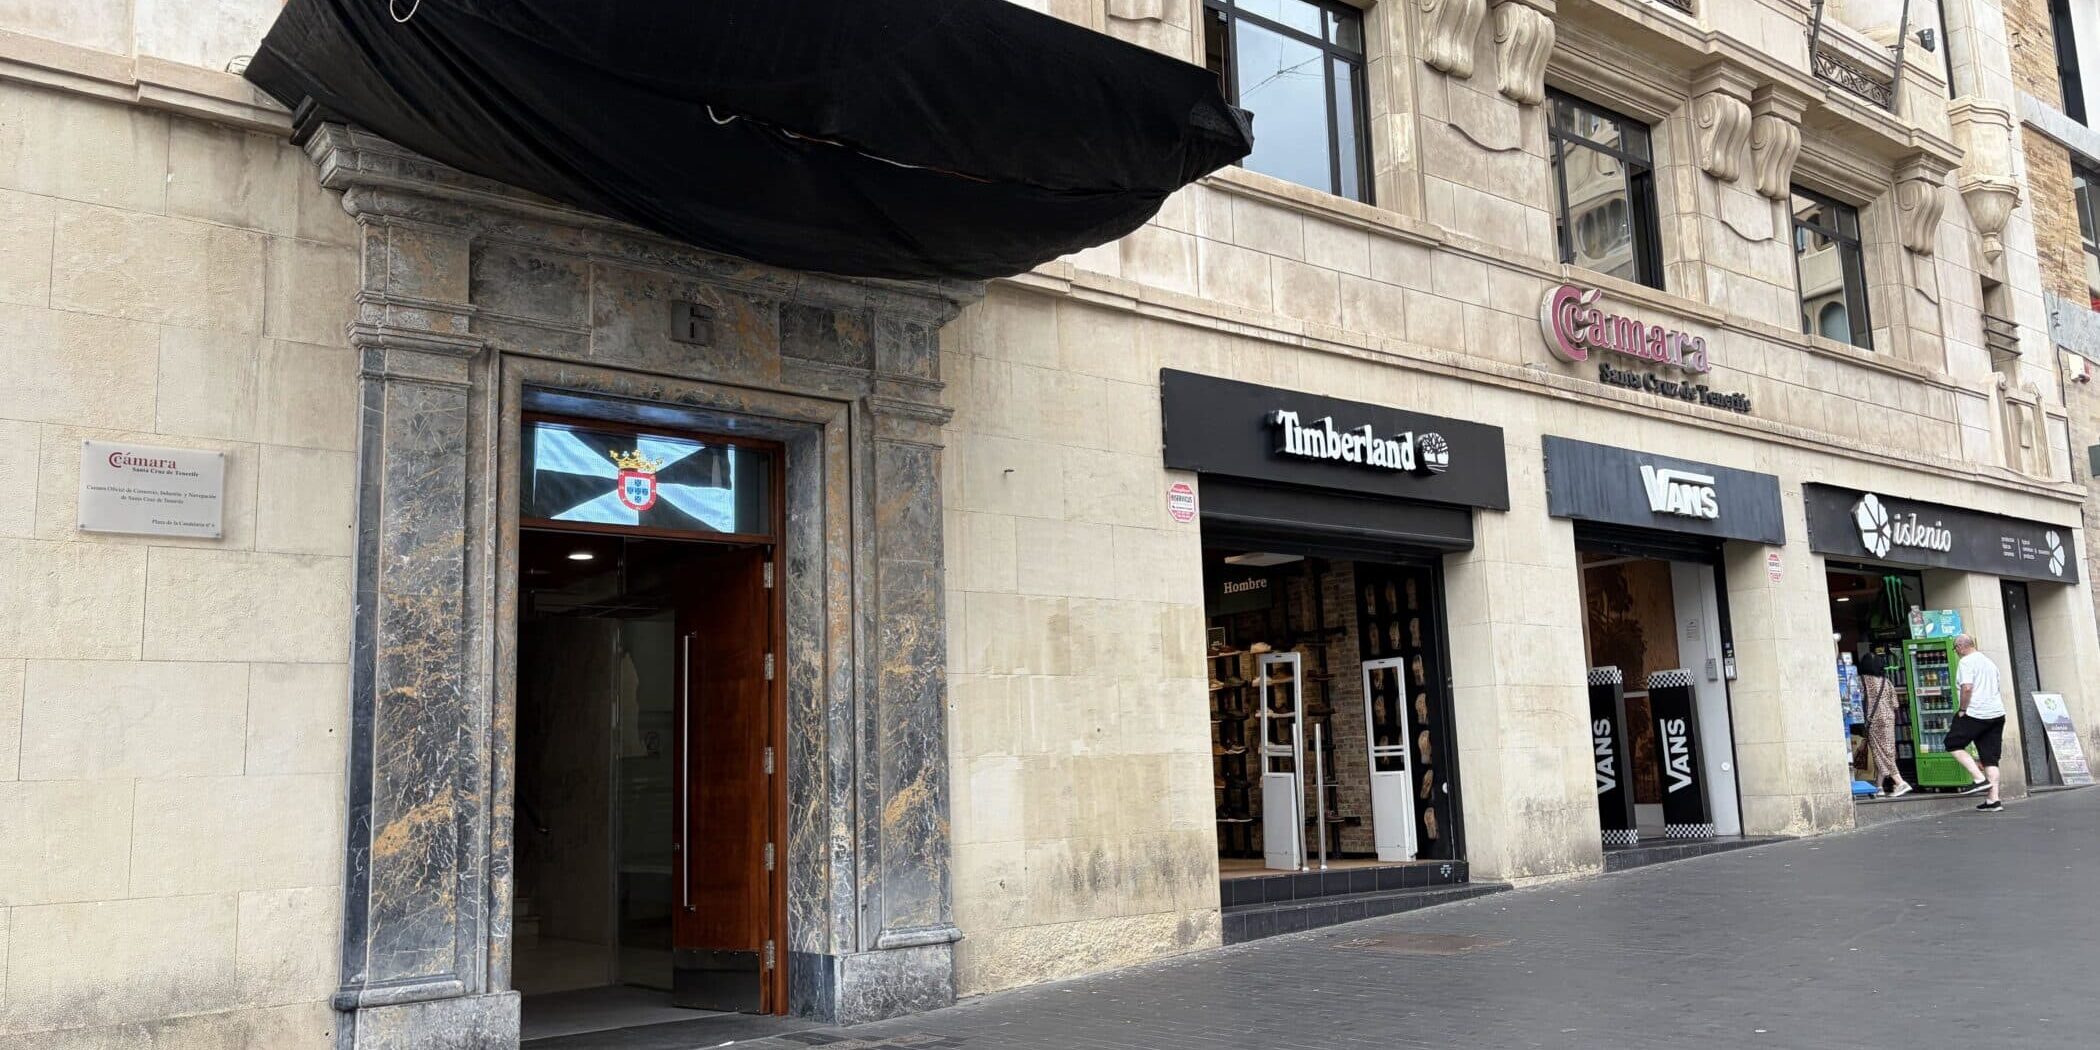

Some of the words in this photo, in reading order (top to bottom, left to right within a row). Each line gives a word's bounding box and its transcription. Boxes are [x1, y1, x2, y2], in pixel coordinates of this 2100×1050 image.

[1599, 362, 1641, 389] Santa
[1643, 372, 1679, 397] Cruz
[1679, 380, 1697, 401] de
[1696, 385, 1751, 412] Tenerife
[1277, 409, 1416, 471] Timberland
[1639, 464, 1719, 520] VANS
[1893, 512, 1951, 553] islenio
[1223, 576, 1268, 595] Hombre
[1593, 718, 1617, 795] VANS
[1660, 718, 1693, 794] VANS
